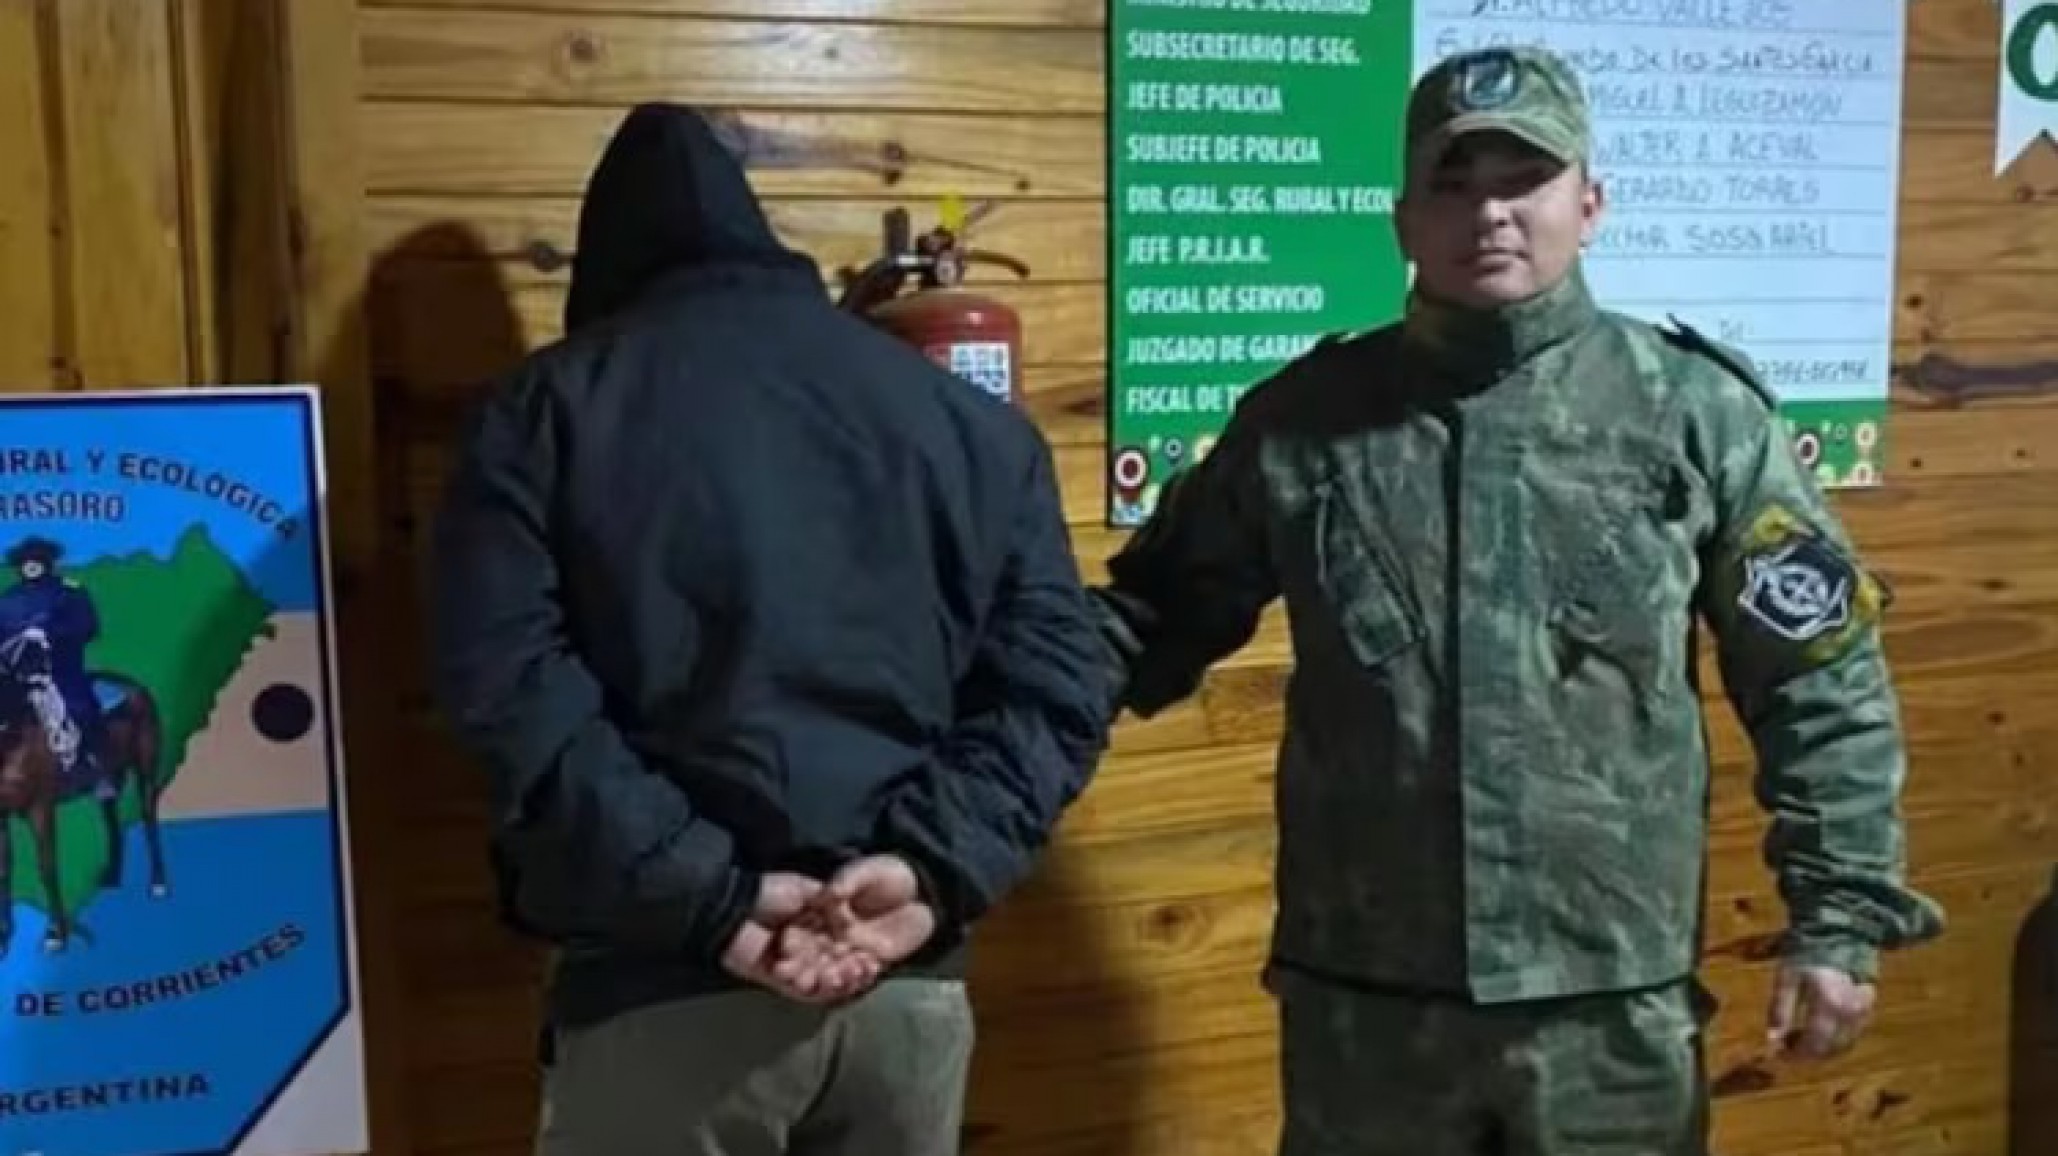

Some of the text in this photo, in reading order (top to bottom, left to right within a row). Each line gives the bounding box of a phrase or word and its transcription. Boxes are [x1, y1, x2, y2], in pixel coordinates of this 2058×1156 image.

[1127, 29, 1360, 65] SUBSECRETARIO DE SEG.
[1127, 82, 1283, 114] JEFE DE POLICIA
[1127, 134, 1321, 163] SUBJEFE DE POLICIA
[1127, 186, 1167, 214] DIR.
[1170, 186, 1227, 214] GRAL.
[1228, 186, 1271, 214] SEG.
[1273, 186, 1336, 214] RURAL
[1337, 187, 1349, 213] Y
[1126, 236, 1169, 264] JEFE
[1127, 285, 1325, 313] OFICIAL DE SERVICIO
[1126, 335, 1216, 363] JUZGADO
[1220, 335, 1246, 362] DE
[1126, 384, 1193, 413] FISCAL
[1195, 385, 1223, 413] DE
[0, 447, 73, 475] RAL
[86, 447, 106, 474] Y
[15, 921, 306, 1016] DE CORRIENTES
[0, 1072, 211, 1117] RGENTINA
